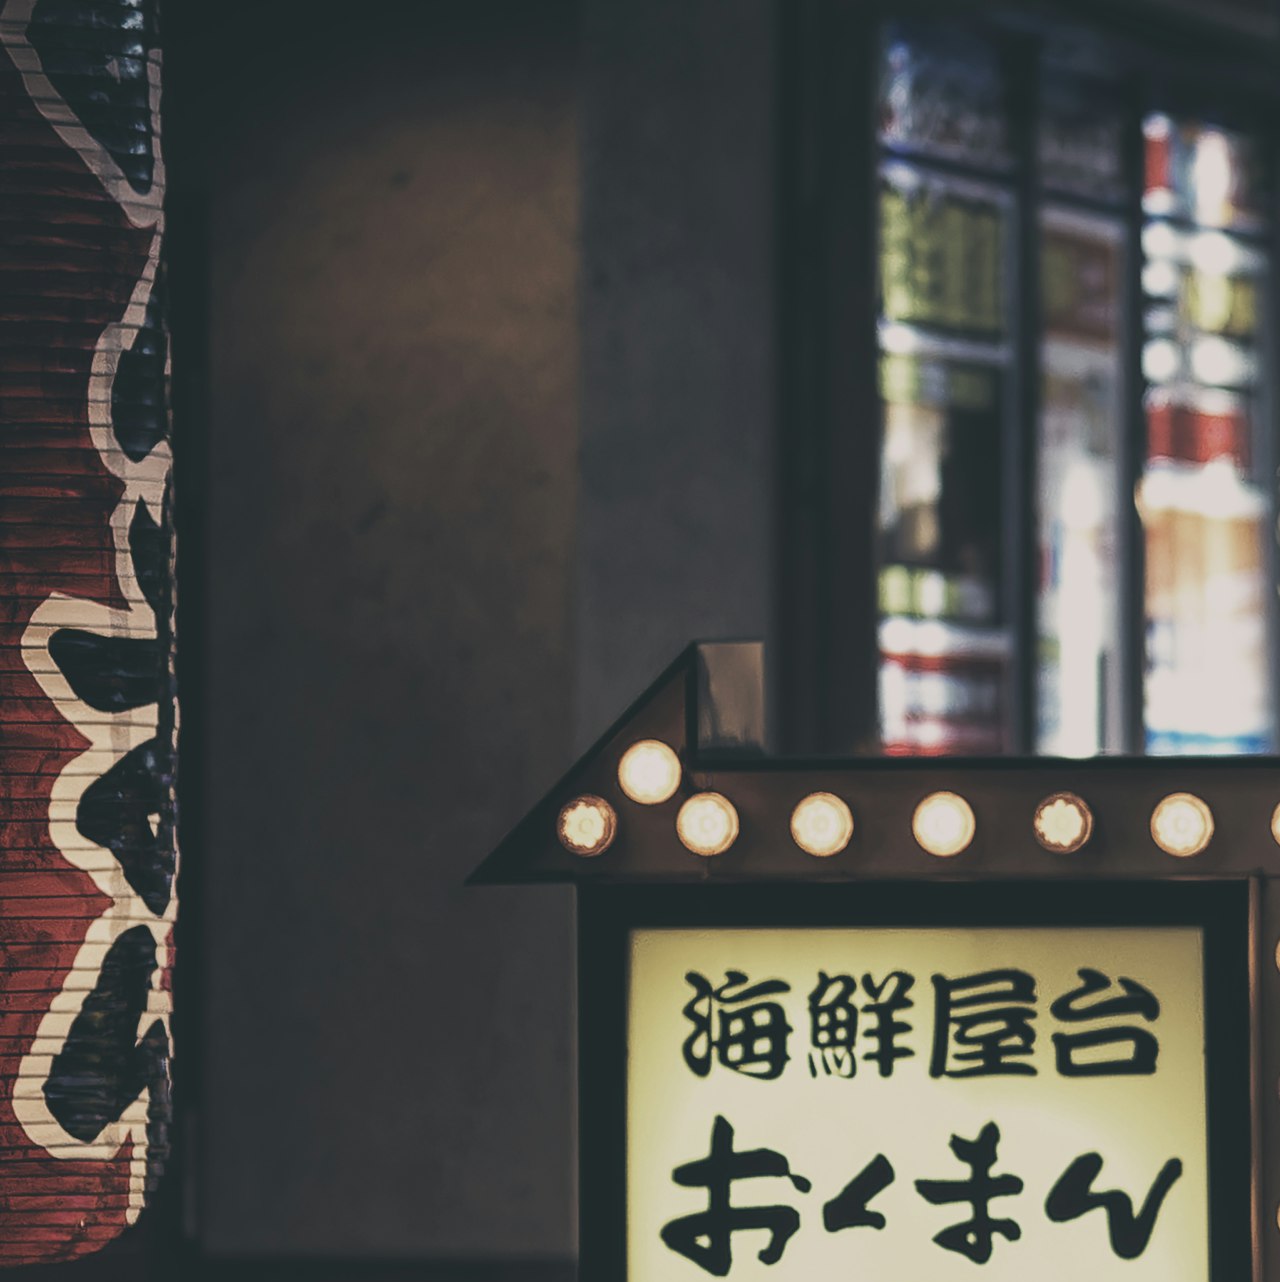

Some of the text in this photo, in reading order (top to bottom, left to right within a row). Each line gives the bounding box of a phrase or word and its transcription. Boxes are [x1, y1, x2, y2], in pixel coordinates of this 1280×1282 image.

[682, 967, 1161, 1081] 海鮮屋台
[660, 1115, 1182, 1277] おくまん
